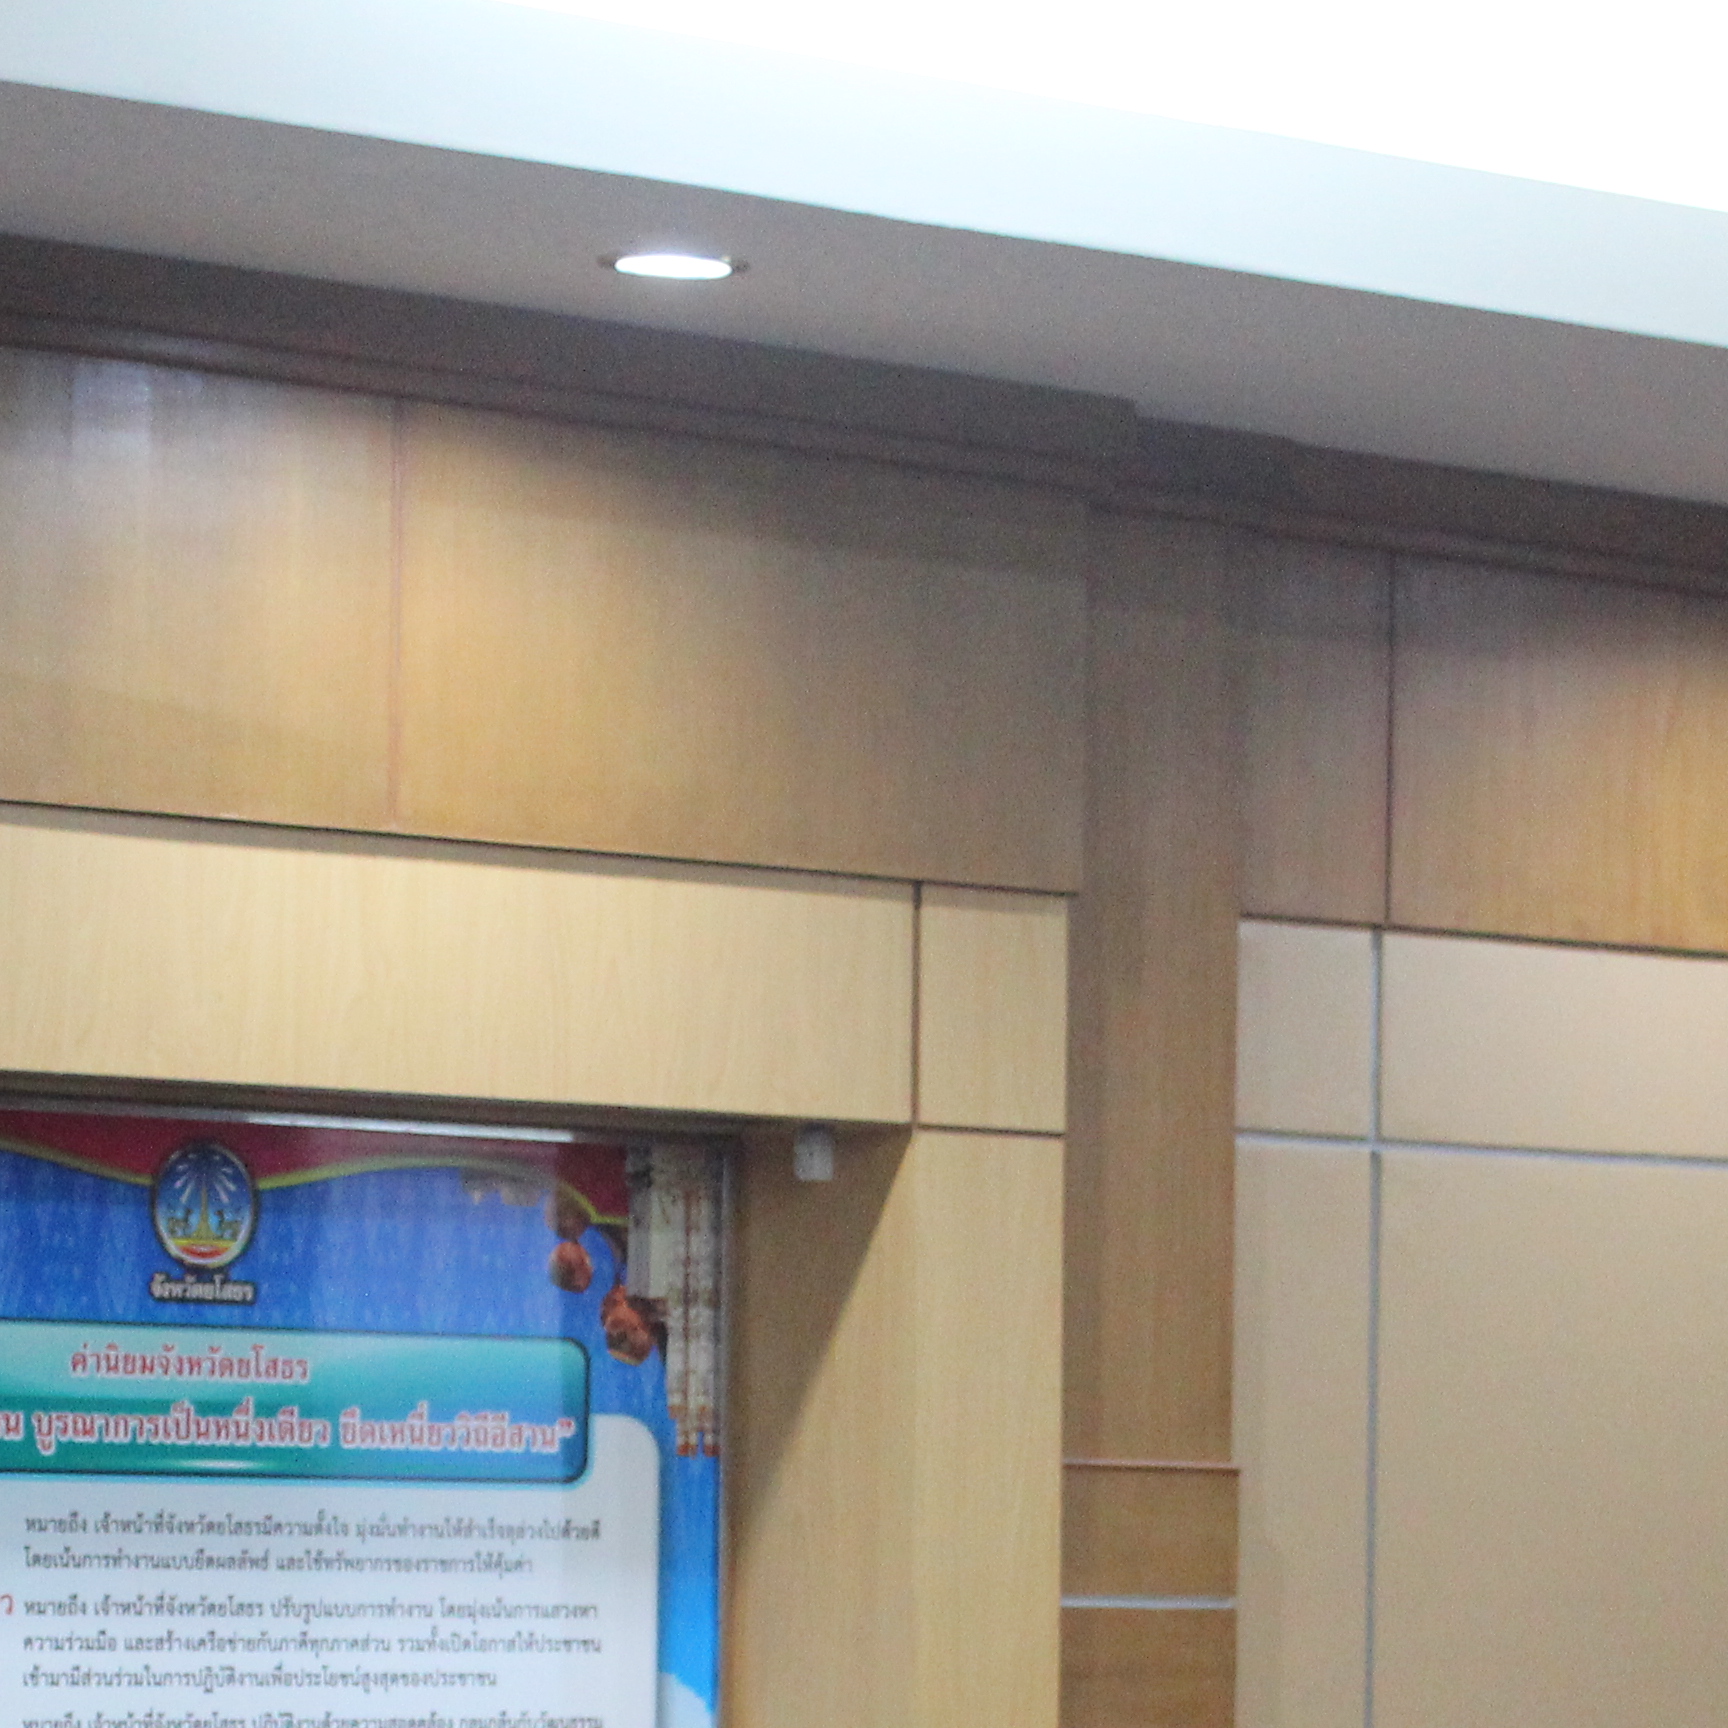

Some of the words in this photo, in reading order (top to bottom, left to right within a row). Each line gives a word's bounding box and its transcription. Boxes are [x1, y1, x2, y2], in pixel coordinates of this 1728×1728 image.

[151, 1272, 254, 1301] จังหวัดยโสธร
[71, 1342, 309, 1382] ค่านิยมจังหวัดยโสธร
[32, 1396, 331, 1455] บูรณาการเป็นหนึ่งเดียว
[25, 1510, 87, 1533] หมายถึง
[24, 1593, 87, 1616] หมายถึง
[94, 1591, 263, 1617] เจ้าหน้าที่จังหวัดยโสธร
[23, 1629, 117, 1651] ความร่วมมือ
